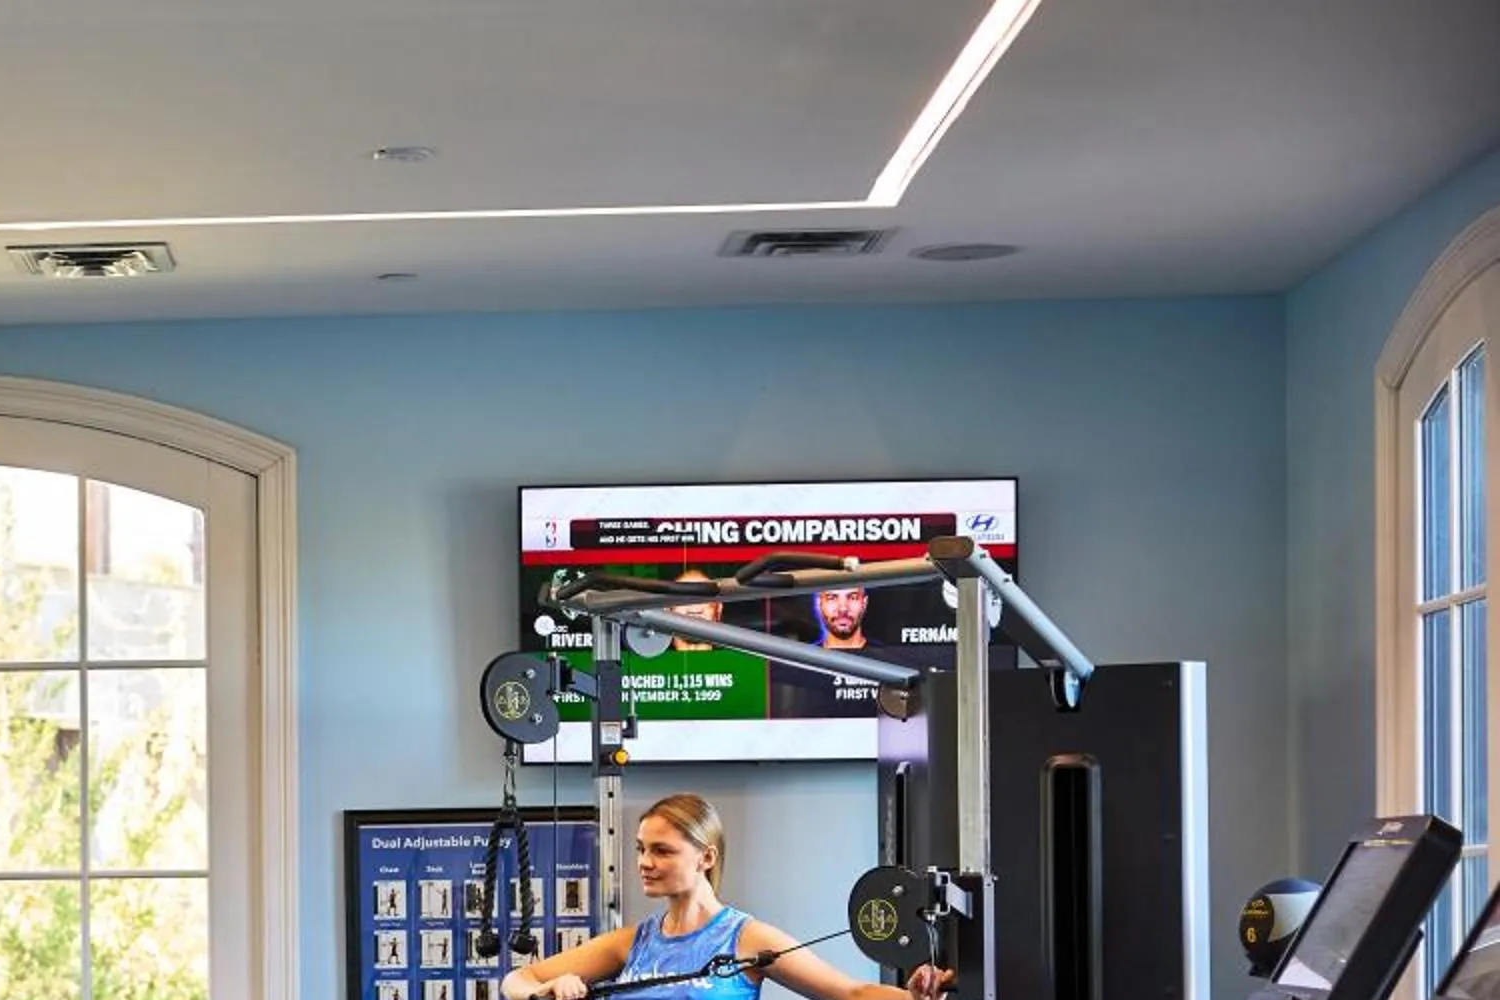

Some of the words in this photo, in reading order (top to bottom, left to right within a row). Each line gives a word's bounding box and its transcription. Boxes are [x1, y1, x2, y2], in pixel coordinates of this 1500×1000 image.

[745, 518, 921, 544] COMPARISON
[674, 674, 703, 690] 1,115
[705, 673, 733, 687] WINS
[694, 689, 722, 701] 1999
[835, 687, 868, 699] FIRST
[372, 838, 400, 849] Dual
[403, 836, 471, 850] Adjustable
[473, 835, 511, 849] Puey
[1247, 927, 1257, 943] 6
